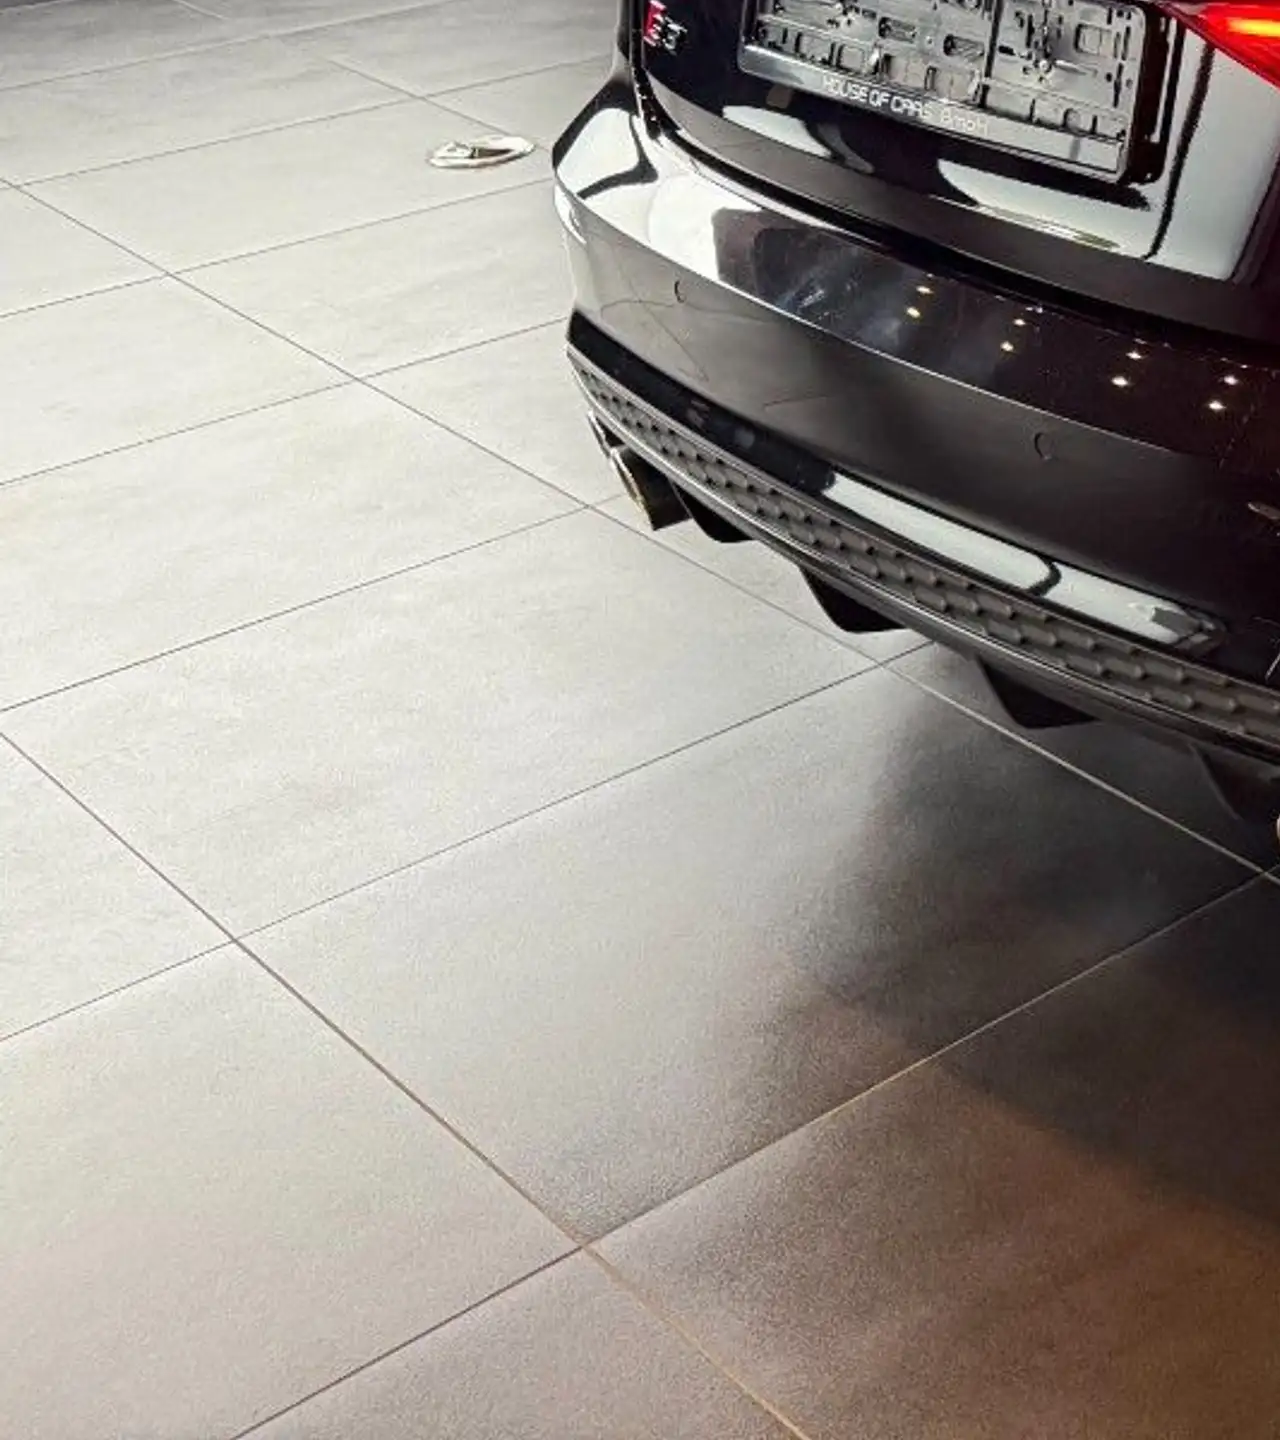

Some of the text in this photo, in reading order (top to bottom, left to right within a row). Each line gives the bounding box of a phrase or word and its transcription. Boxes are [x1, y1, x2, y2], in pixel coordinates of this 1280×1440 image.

[822, 75, 868, 103] HOUSE
[868, 89, 890, 108] OF
[890, 95, 933, 120] CARS
